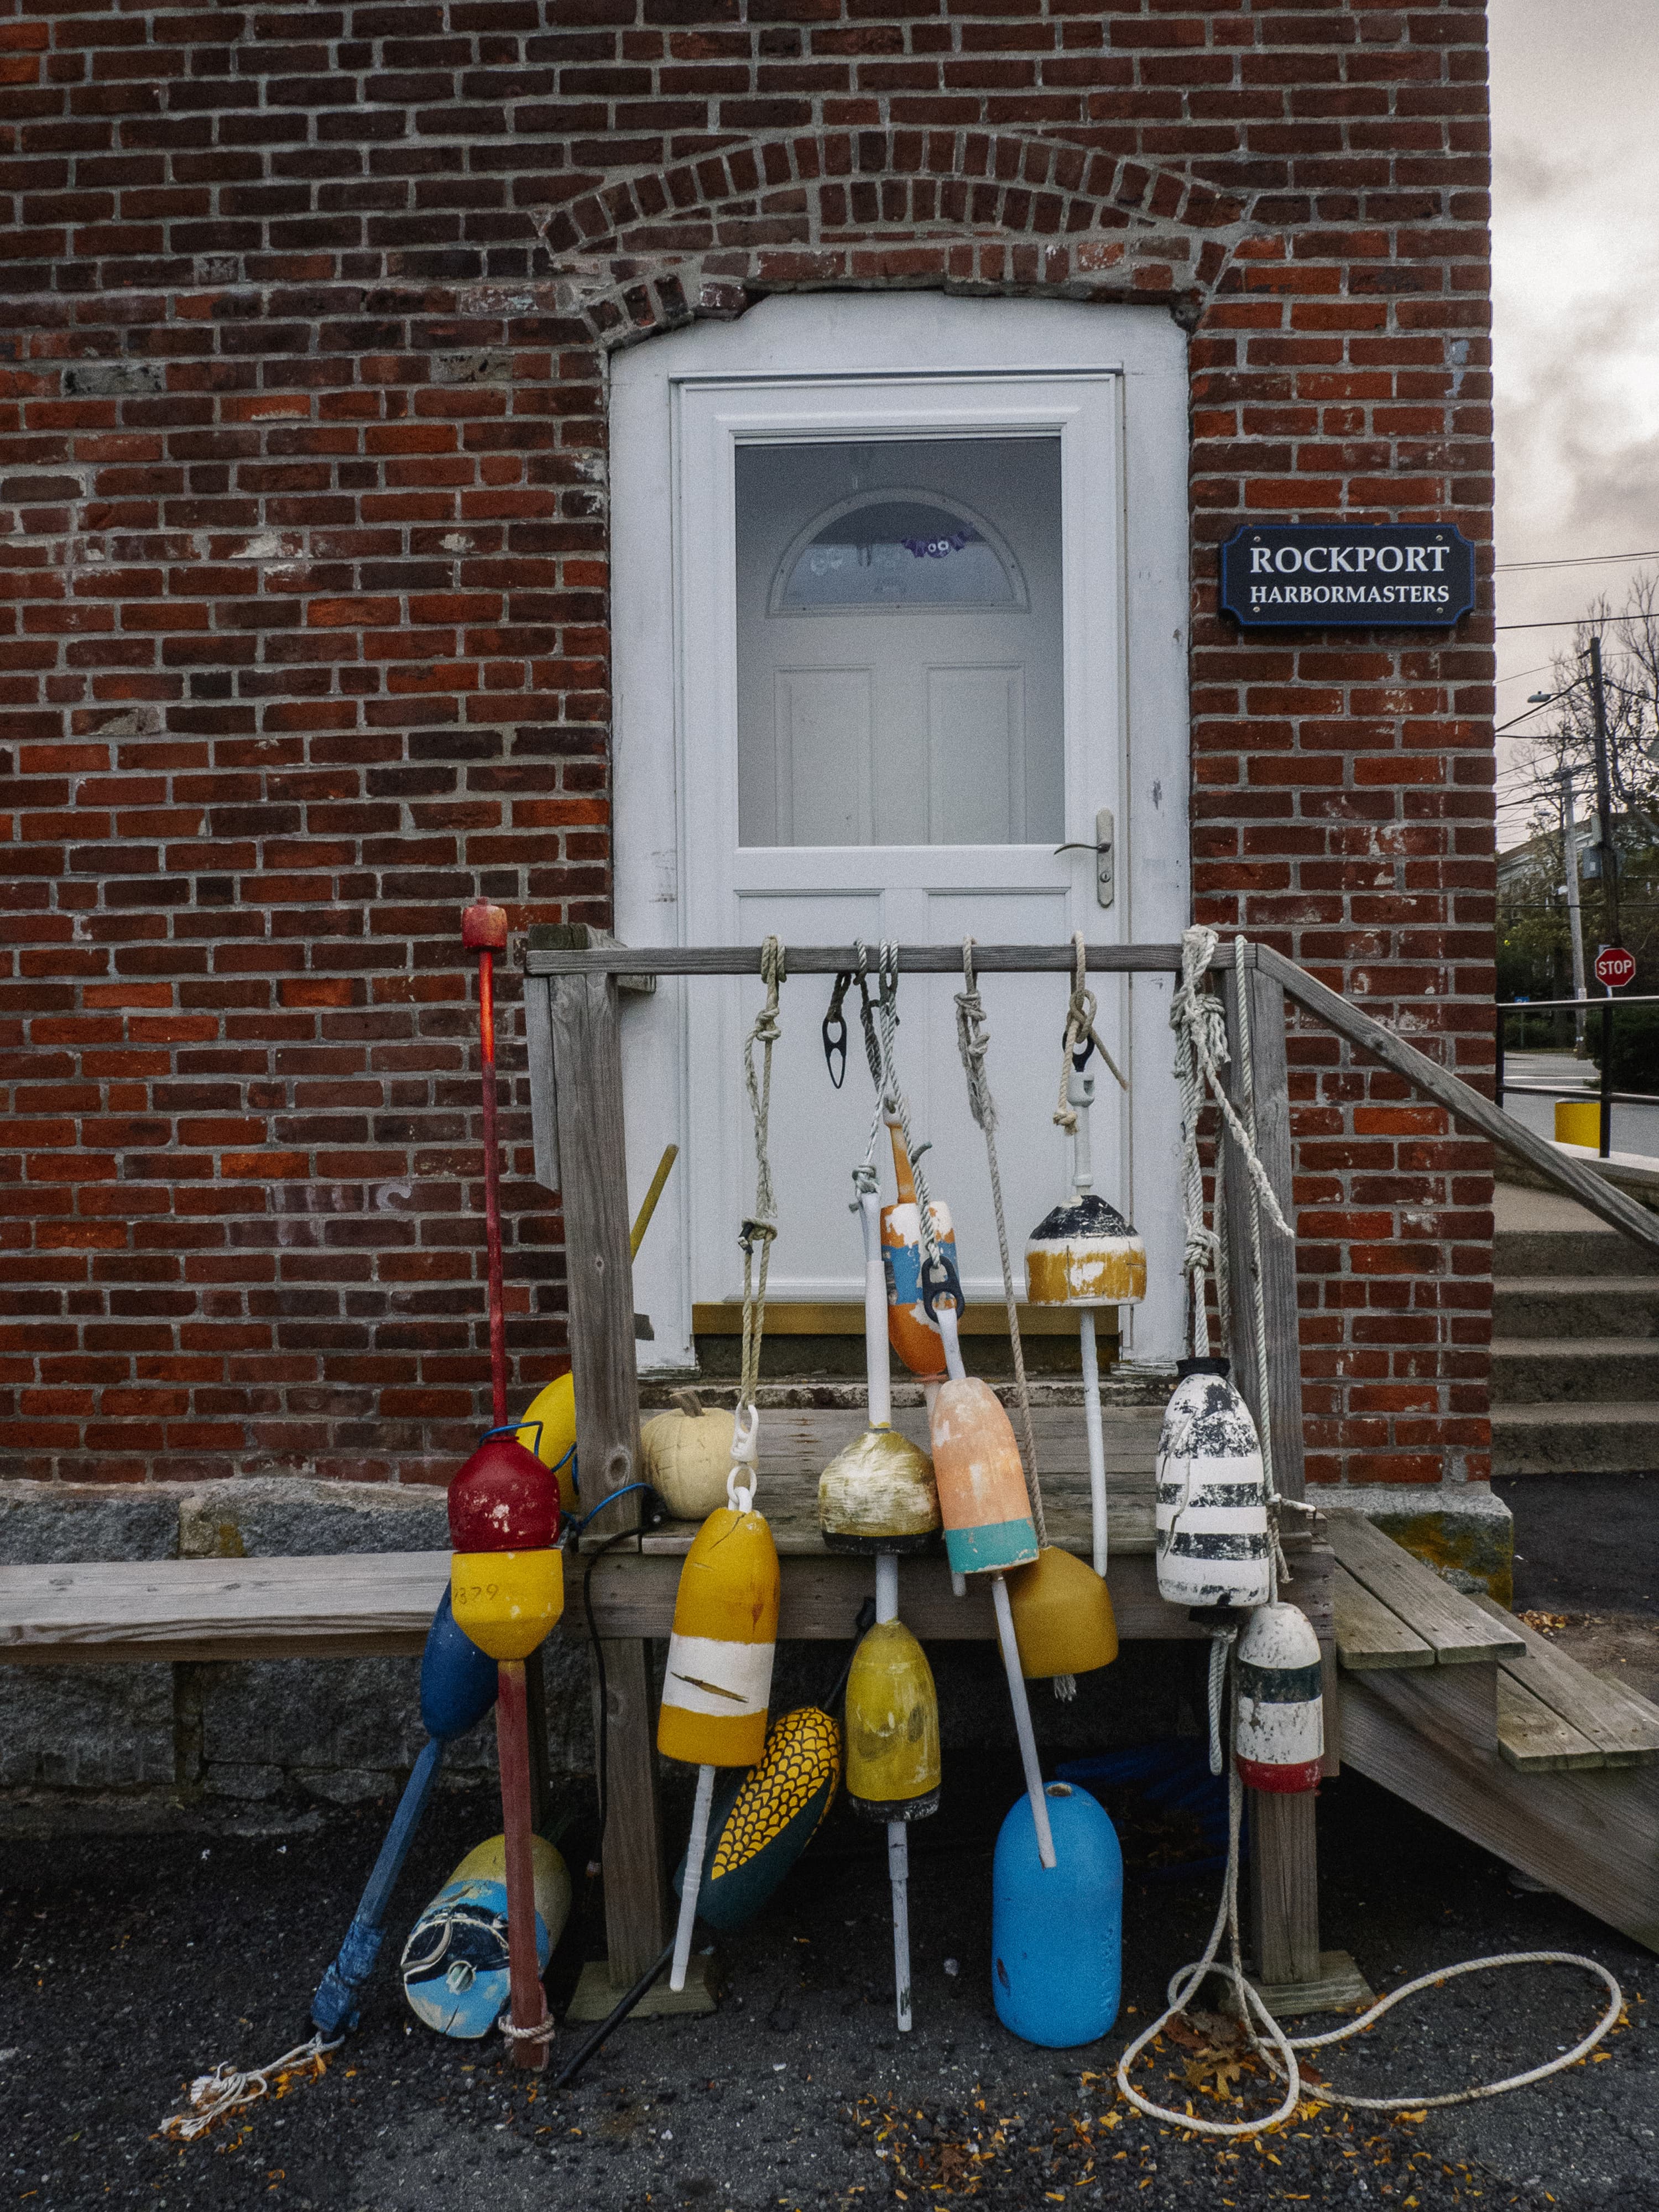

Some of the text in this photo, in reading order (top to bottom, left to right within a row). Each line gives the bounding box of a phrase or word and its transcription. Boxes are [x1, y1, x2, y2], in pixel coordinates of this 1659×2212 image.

[1250, 546, 1450, 573] ROCKPORT
[1250, 585, 1450, 603] HARBORMASTERS
[1598, 959, 1632, 976] STOP
